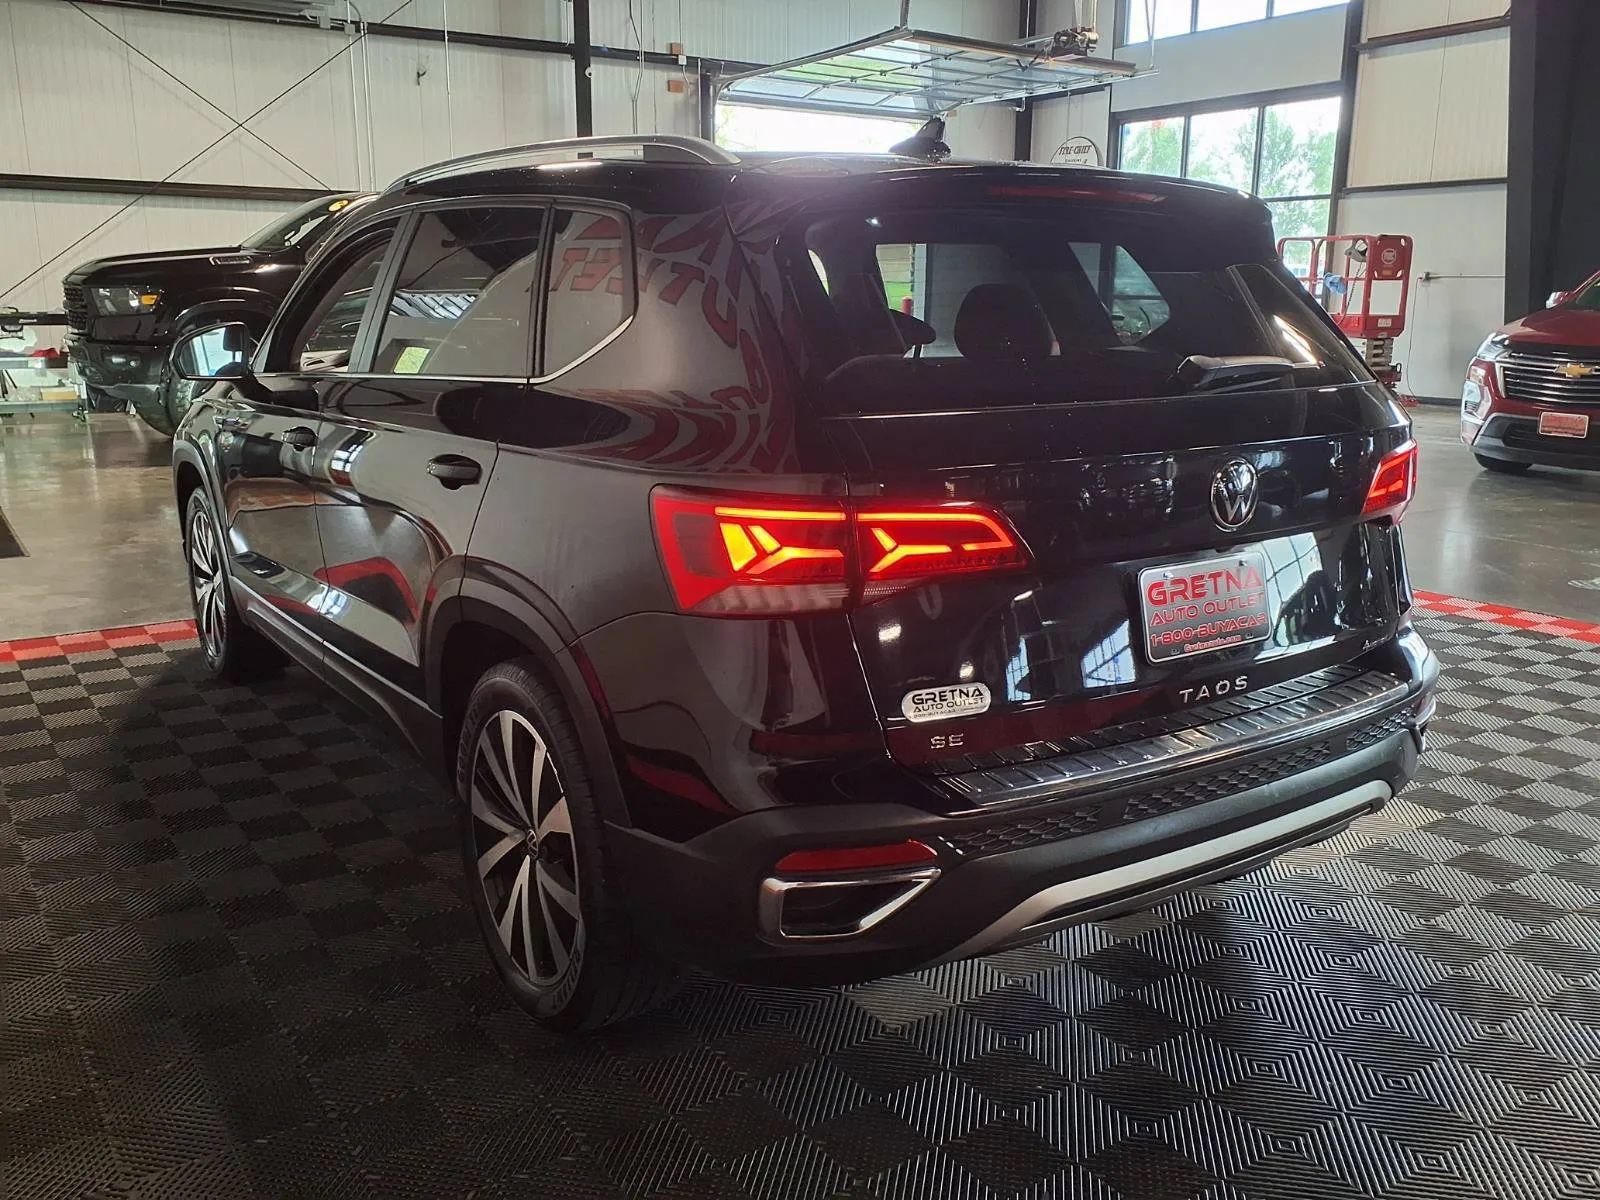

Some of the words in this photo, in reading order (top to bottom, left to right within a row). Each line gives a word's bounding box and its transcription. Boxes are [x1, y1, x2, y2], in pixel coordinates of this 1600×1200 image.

[1147, 566, 1263, 606] GRETNA
[1150, 605, 1199, 627] AUTO
[1203, 591, 1264, 616] OUTLET
[912, 686, 984, 705] GRETNA
[1179, 675, 1248, 704] TAOS
[914, 703, 944, 713] AUTO
[946, 697, 985, 708] OUTLET
[930, 733, 964, 749] SE
